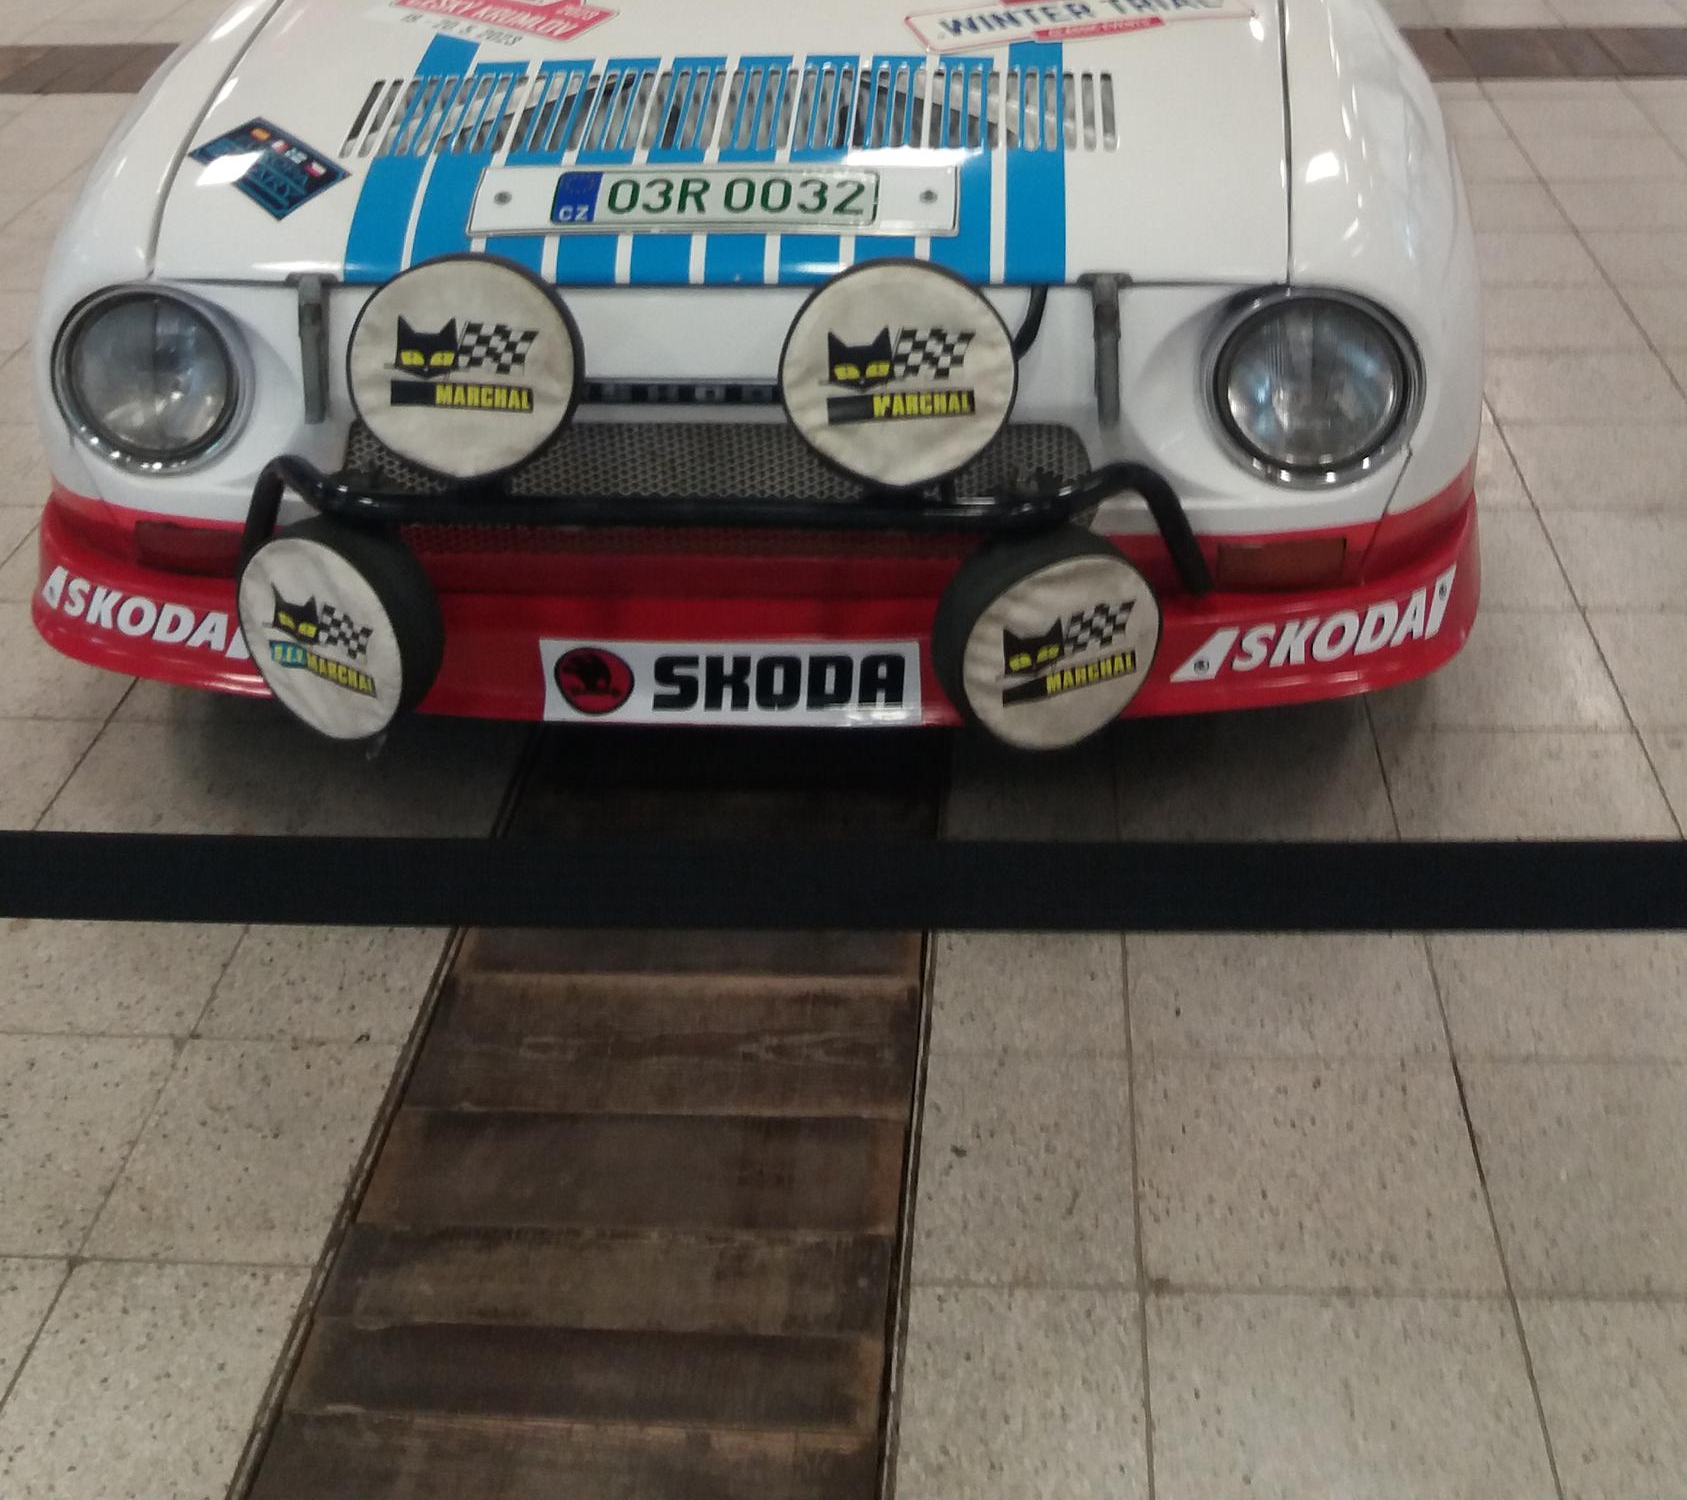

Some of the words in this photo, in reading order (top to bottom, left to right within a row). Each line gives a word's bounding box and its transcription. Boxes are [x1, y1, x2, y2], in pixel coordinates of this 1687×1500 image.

[937, 2, 1092, 37] WINTER
[558, 205, 588, 221] CZ
[608, 178, 711, 215] 03R
[723, 178, 866, 215] 0032
[435, 383, 531, 410] MARCHAL
[873, 390, 969, 419] MARCHAL
[65, 577, 229, 651] SKODA
[1231, 580, 1430, 672] SKODA
[306, 653, 376, 695] MARCHAL
[652, 653, 906, 713] SKODA
[1046, 651, 1136, 695] MARCHAL
